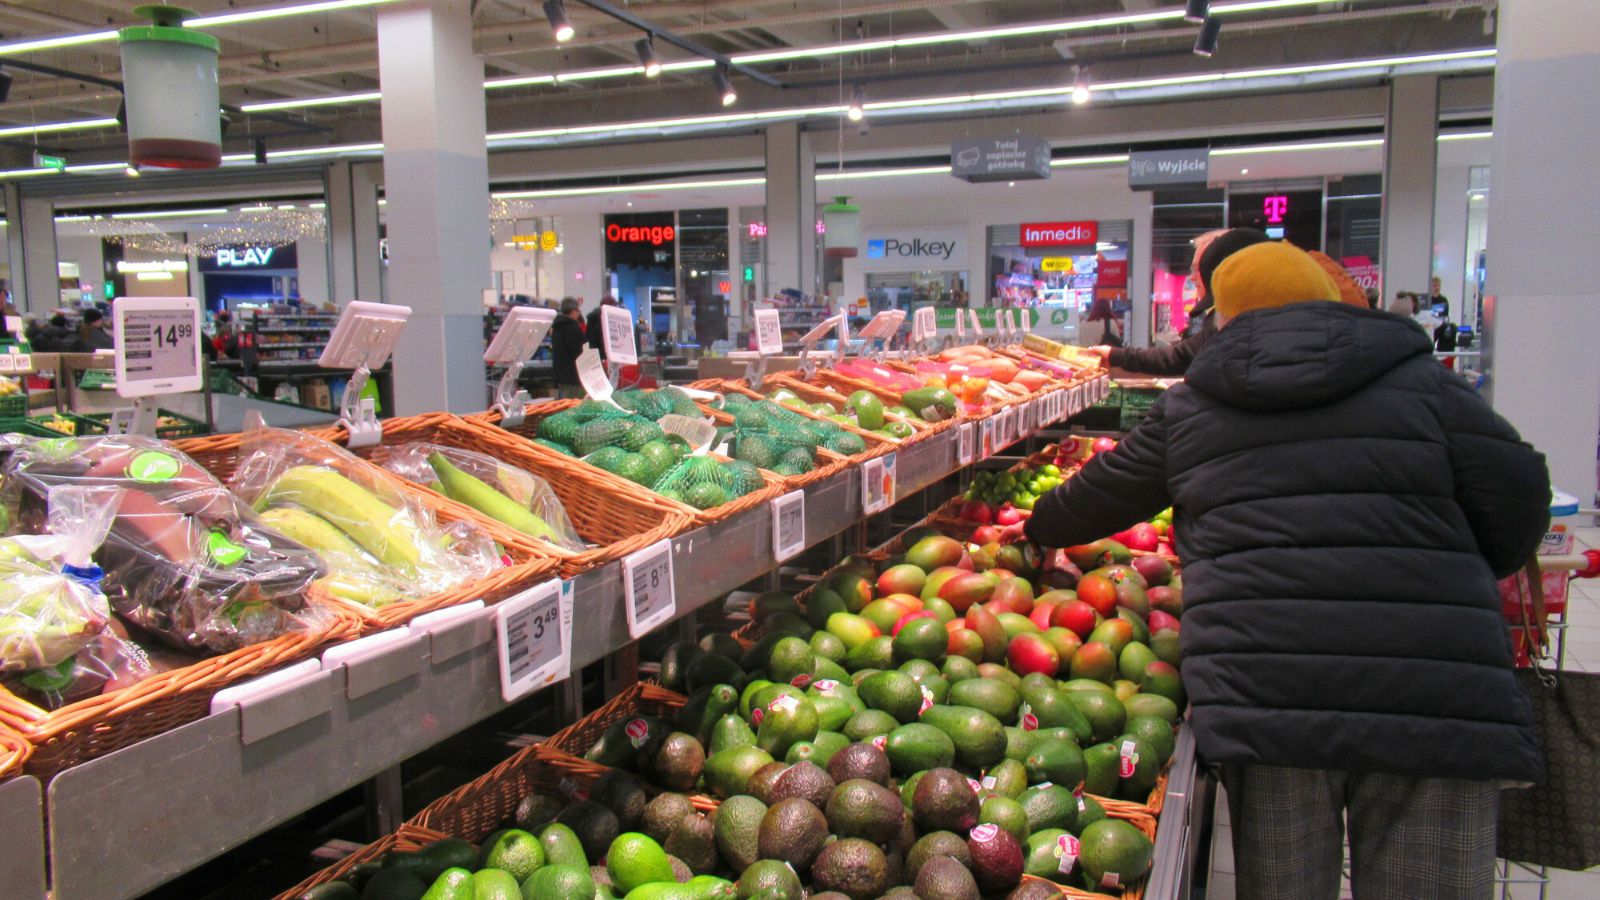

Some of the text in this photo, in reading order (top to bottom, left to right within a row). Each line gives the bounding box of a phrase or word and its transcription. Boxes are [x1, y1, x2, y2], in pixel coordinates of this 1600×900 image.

[994, 140, 1018, 152] Tutaj
[1157, 158, 1206, 174] Wyjście
[606, 223, 674, 246] Orange
[1025, 227, 1091, 242] inmedio
[217, 247, 273, 266] PLAY
[885, 238, 956, 260] Polkey
